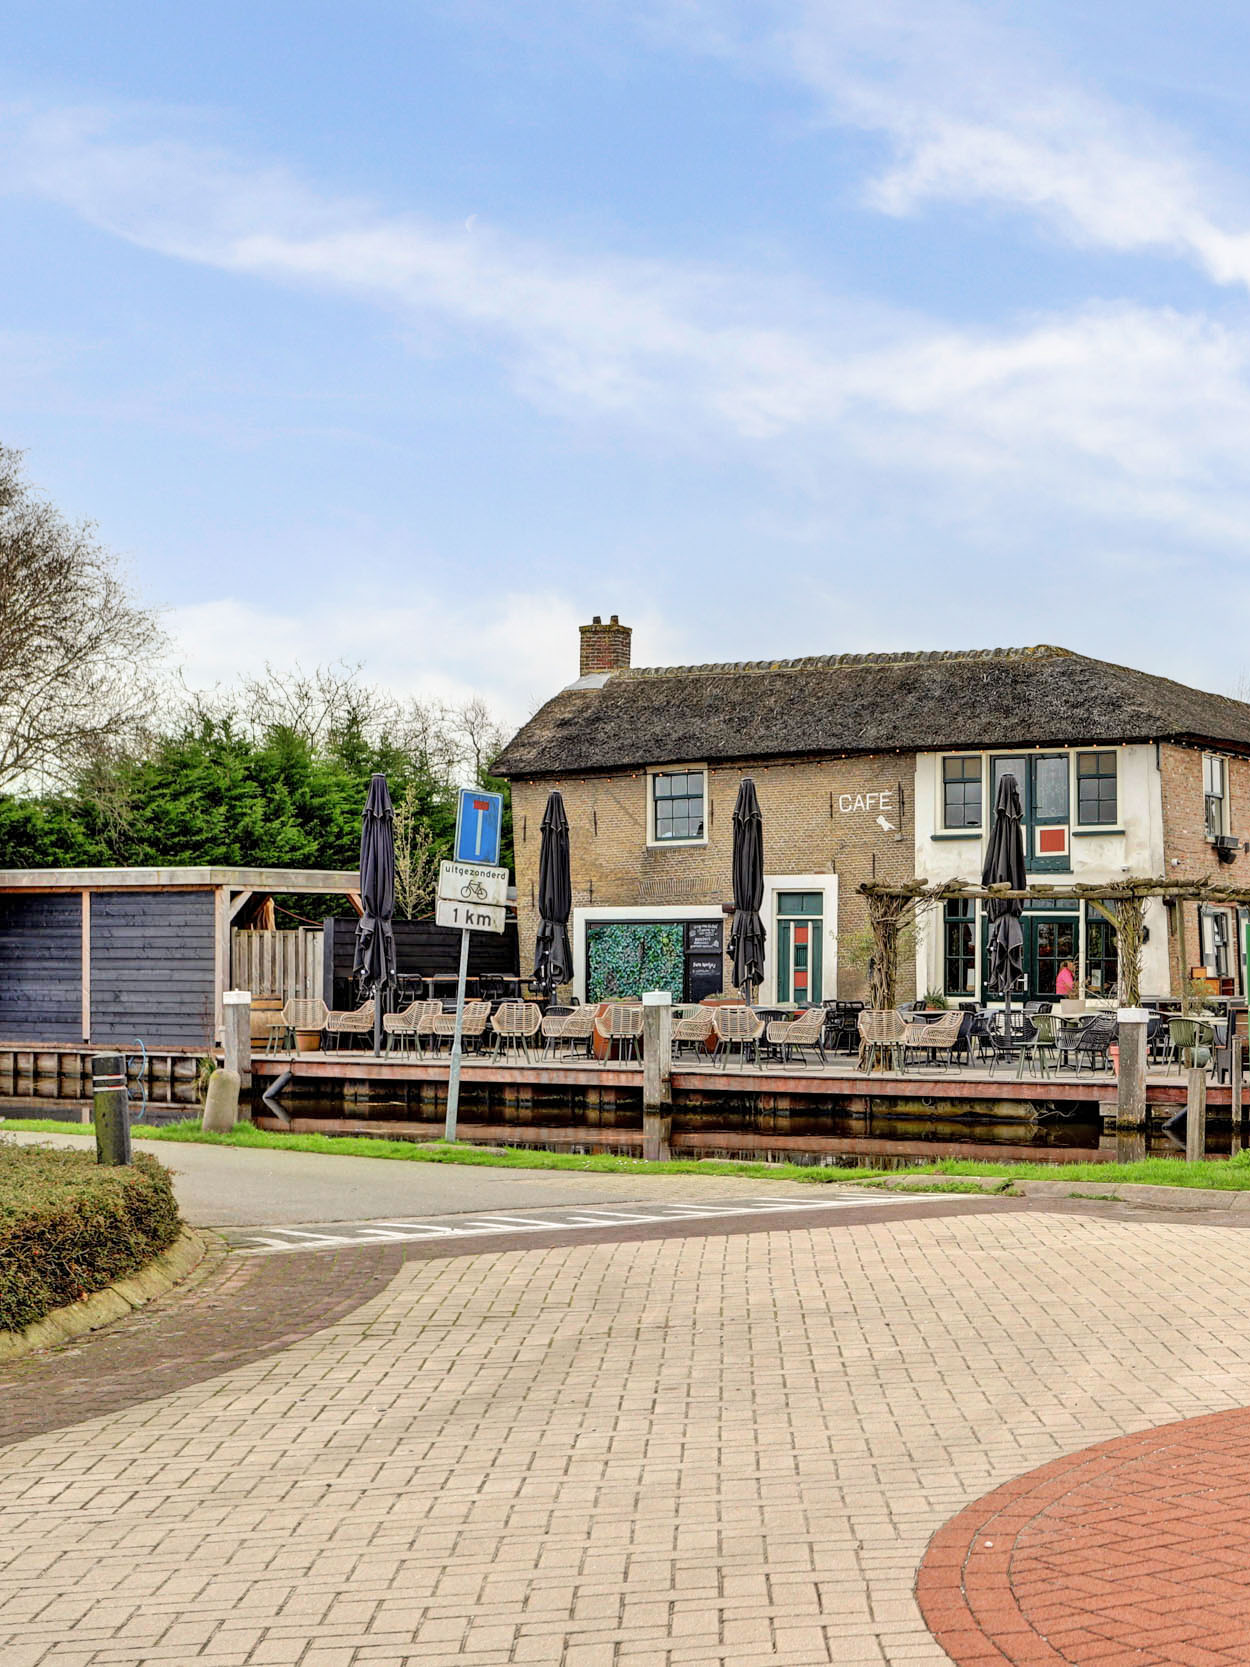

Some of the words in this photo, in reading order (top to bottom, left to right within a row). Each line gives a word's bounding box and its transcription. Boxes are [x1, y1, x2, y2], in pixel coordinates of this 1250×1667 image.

[445, 865, 506, 880] uitgezonderd
[453, 907, 458, 923] 1
[465, 909, 491, 927] km
